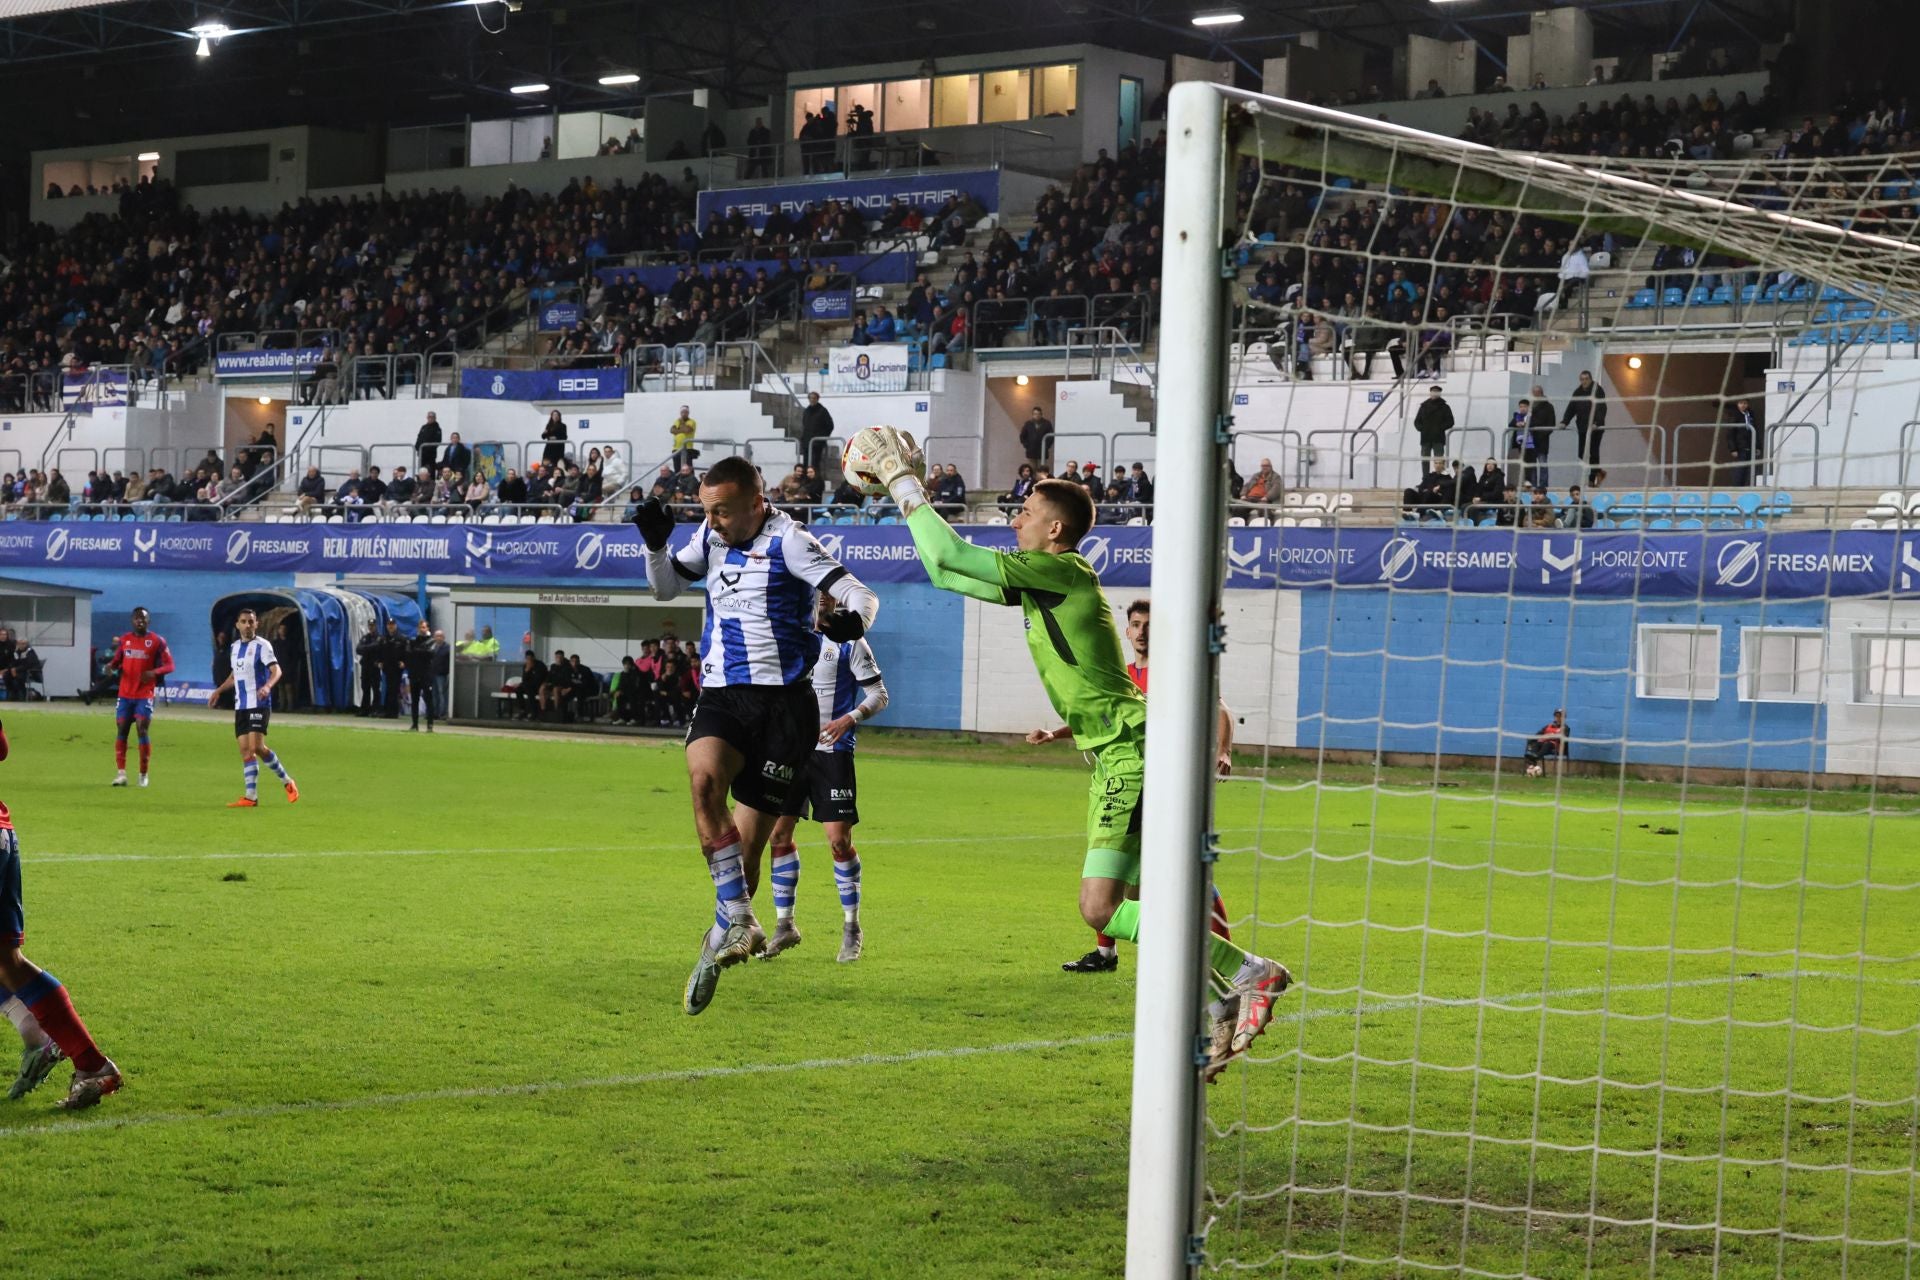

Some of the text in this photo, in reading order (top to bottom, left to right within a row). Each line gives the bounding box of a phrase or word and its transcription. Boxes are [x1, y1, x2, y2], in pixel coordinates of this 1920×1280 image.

[559, 378, 598, 391] 1903
[69, 536, 121, 551] FRESAMEX
[159, 537, 213, 550] HORIZONTE
[252, 539, 310, 554] FRESAMEX
[323, 534, 450, 559] REAL AVILÉS INDUSTRIAL
[496, 541, 559, 555] HORIZONTE
[846, 545, 920, 560] FRESAMEX
[1269, 547, 1355, 564] HORIZONTE
[1423, 552, 1517, 568] FRESAMEX
[1591, 551, 1688, 567] HORIZONTE
[1767, 554, 1873, 573] FRESAMEX
